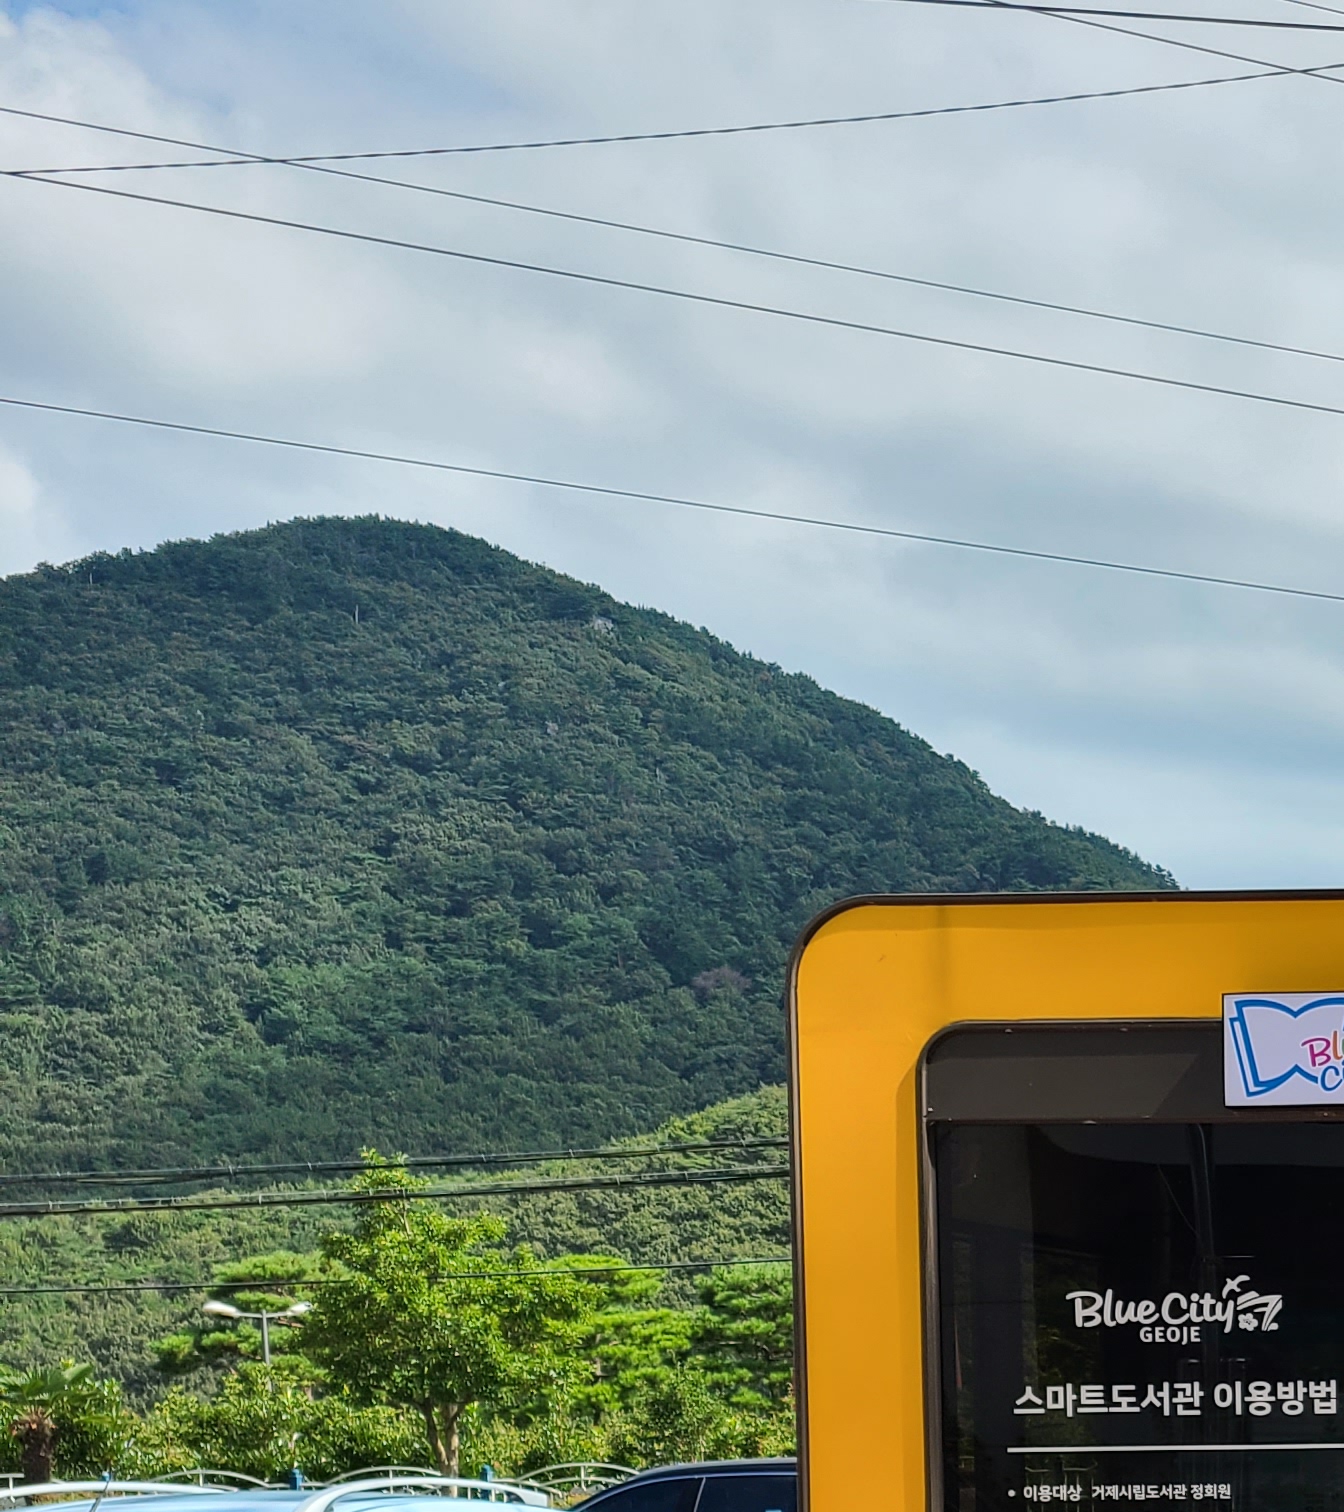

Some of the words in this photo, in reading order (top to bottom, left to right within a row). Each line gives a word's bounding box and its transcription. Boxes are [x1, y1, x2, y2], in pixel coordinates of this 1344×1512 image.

[1065, 1287, 1158, 1328] Blue
[1161, 1290, 1235, 1333] City
[1139, 1326, 1201, 1346] GEOJE
[1013, 1381, 1205, 1418] 스마트도서관
[1213, 1379, 1337, 1416] 이용방법
[1023, 1483, 1083, 1502] 이용대상
[1091, 1483, 1188, 1501] 거제시립도서관
[1190, 1483, 1231, 1500] 정회원
